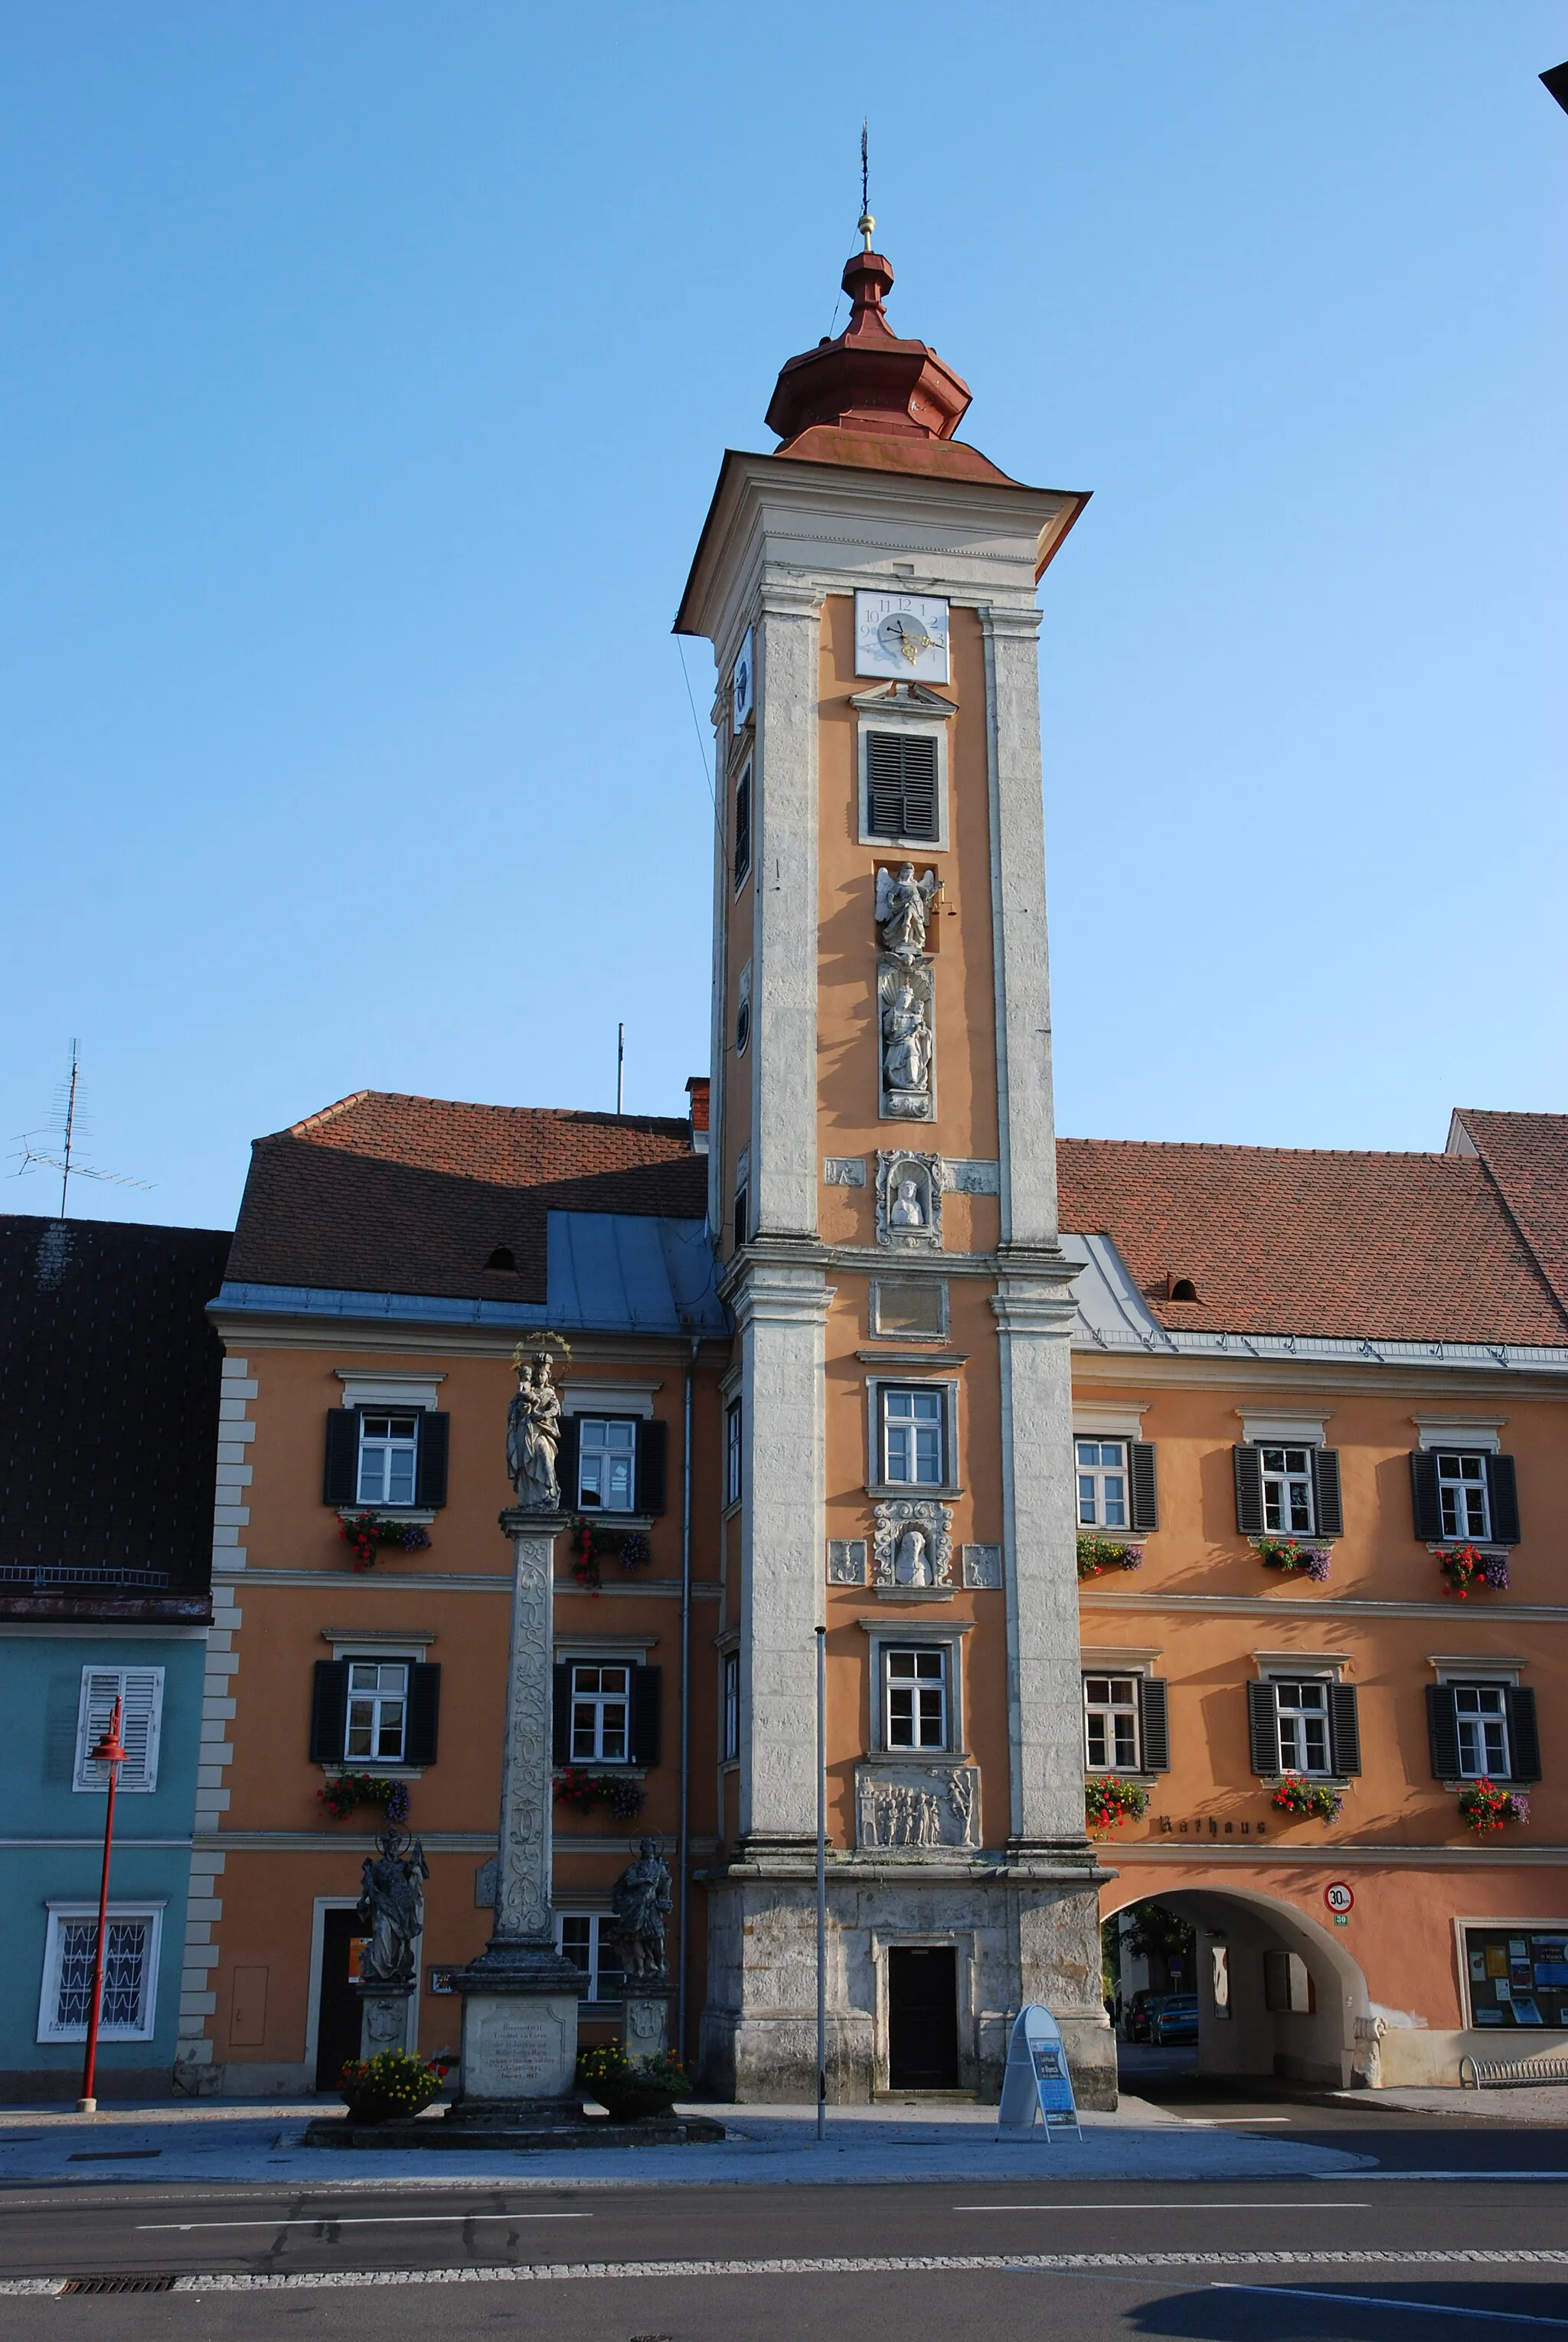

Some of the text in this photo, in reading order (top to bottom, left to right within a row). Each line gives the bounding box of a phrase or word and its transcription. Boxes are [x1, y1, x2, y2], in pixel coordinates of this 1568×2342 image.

[879, 599, 891, 612] 11
[897, 598, 912, 612] 12
[919, 604, 925, 616] 1
[865, 610, 880, 622] 10
[929, 616, 939, 629] 2
[861, 625, 871, 638] 9
[936, 633, 944, 646] 3
[1159, 1815, 1266, 1837] Rathaus
[1329, 1890, 1343, 1905] 30
